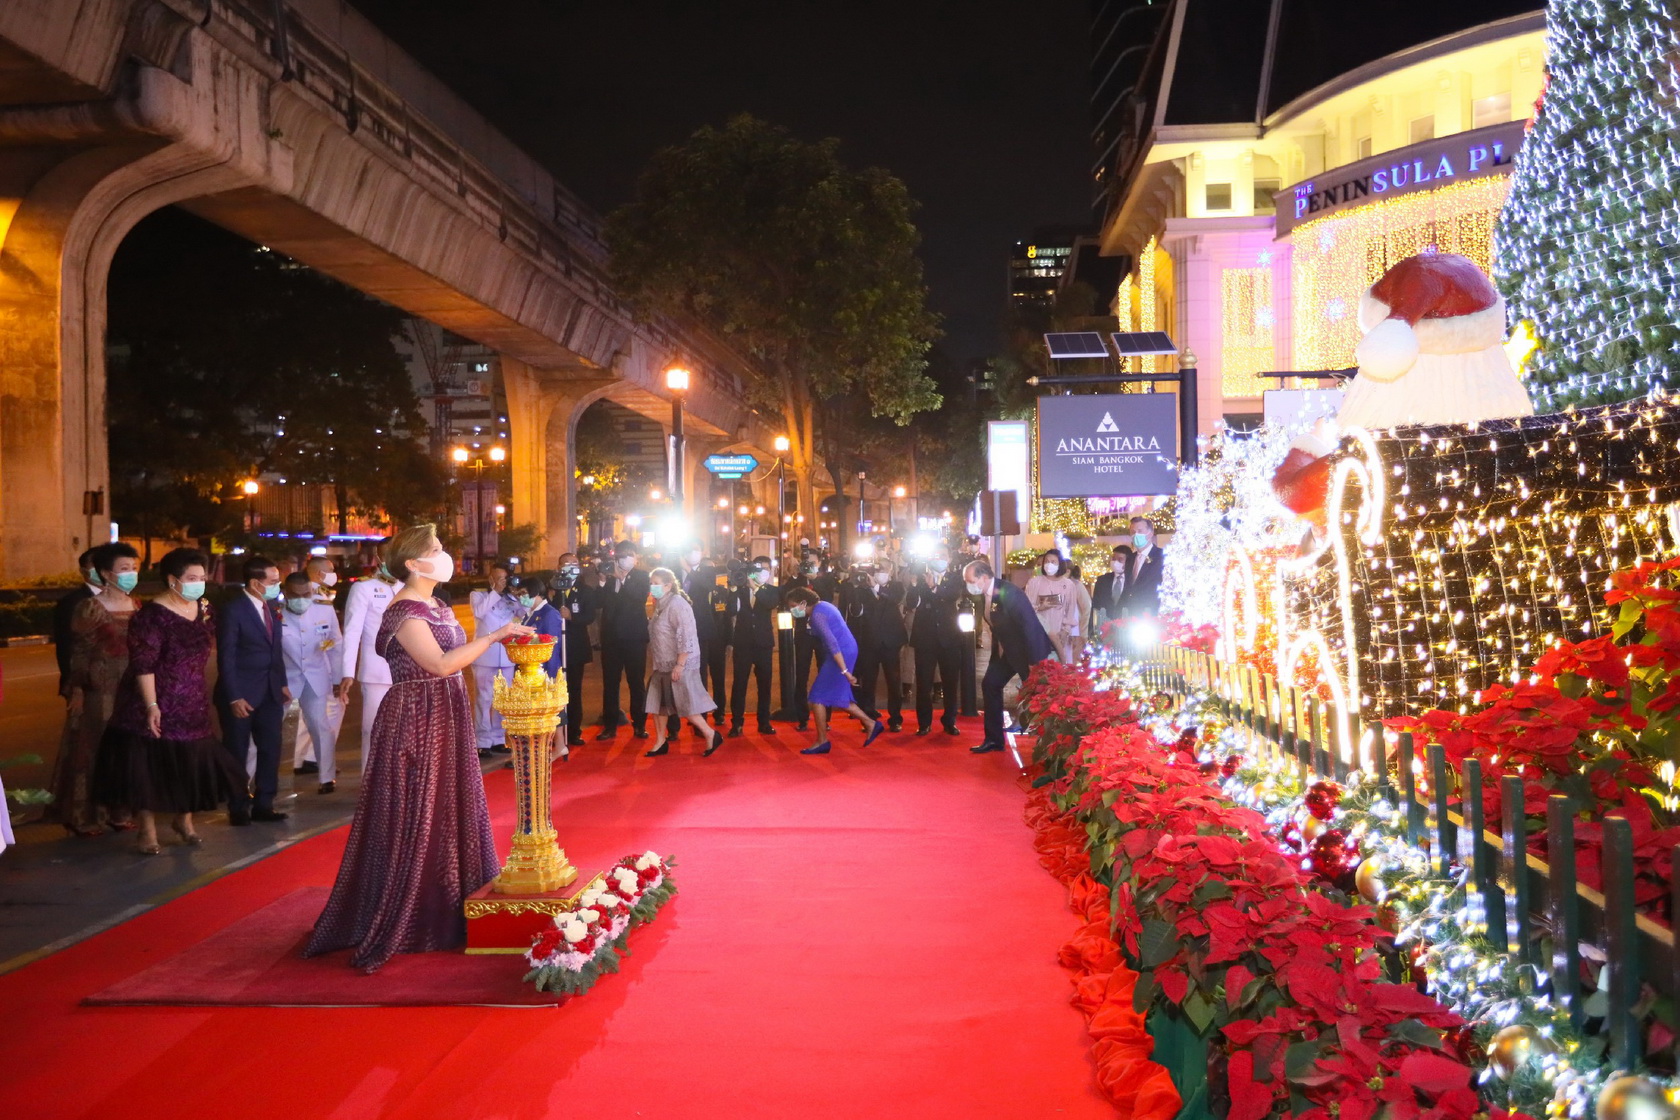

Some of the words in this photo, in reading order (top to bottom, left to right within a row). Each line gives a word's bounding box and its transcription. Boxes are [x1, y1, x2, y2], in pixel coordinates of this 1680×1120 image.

[1294, 154, 1455, 219] PENINSULA
[1294, 183, 1314, 197] THE
[1056, 436, 1161, 452] ANANTARA
[1072, 457, 1095, 465] SIAM
[1099, 456, 1144, 464] BANGKOK
[1094, 465, 1124, 473] HOTEL
